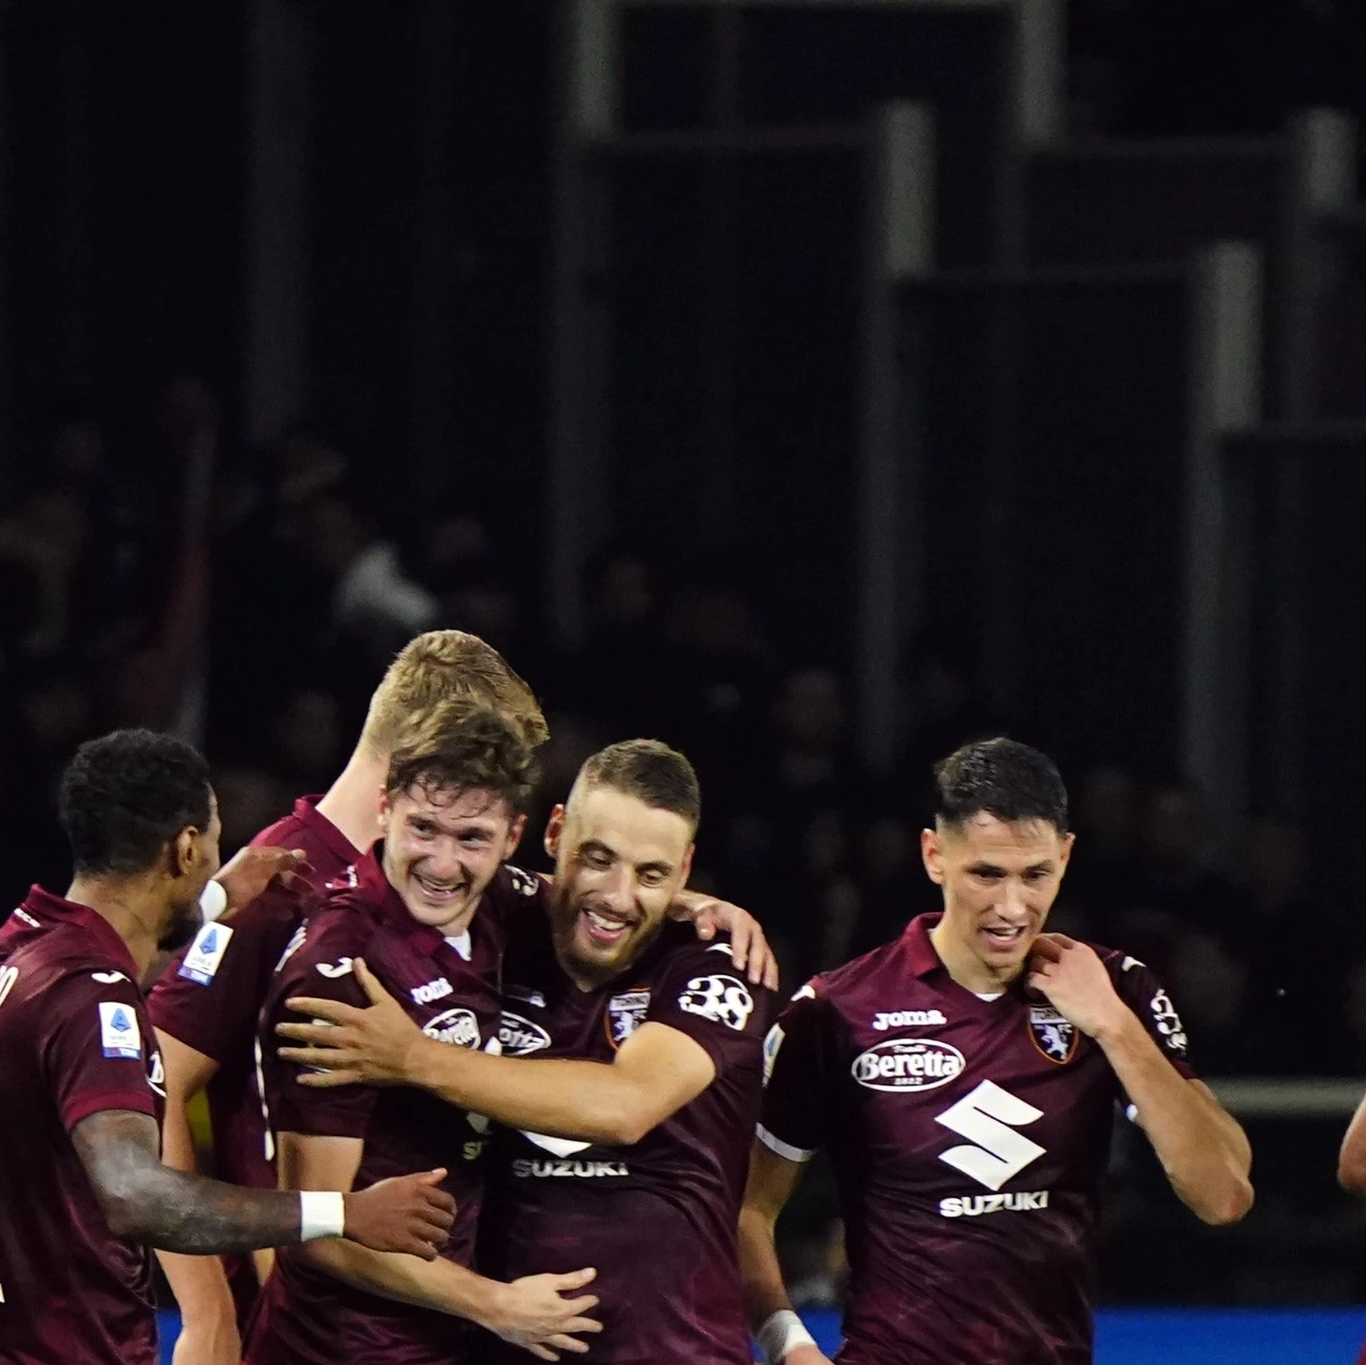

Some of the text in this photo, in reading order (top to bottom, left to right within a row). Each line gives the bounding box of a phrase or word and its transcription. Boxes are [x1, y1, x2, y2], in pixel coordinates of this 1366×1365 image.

[872, 1009, 947, 1030] Joma
[857, 1050, 963, 1082] Beretta
[513, 1158, 629, 1178] SUZUKI
[939, 1190, 1049, 1218] SUZUKI
